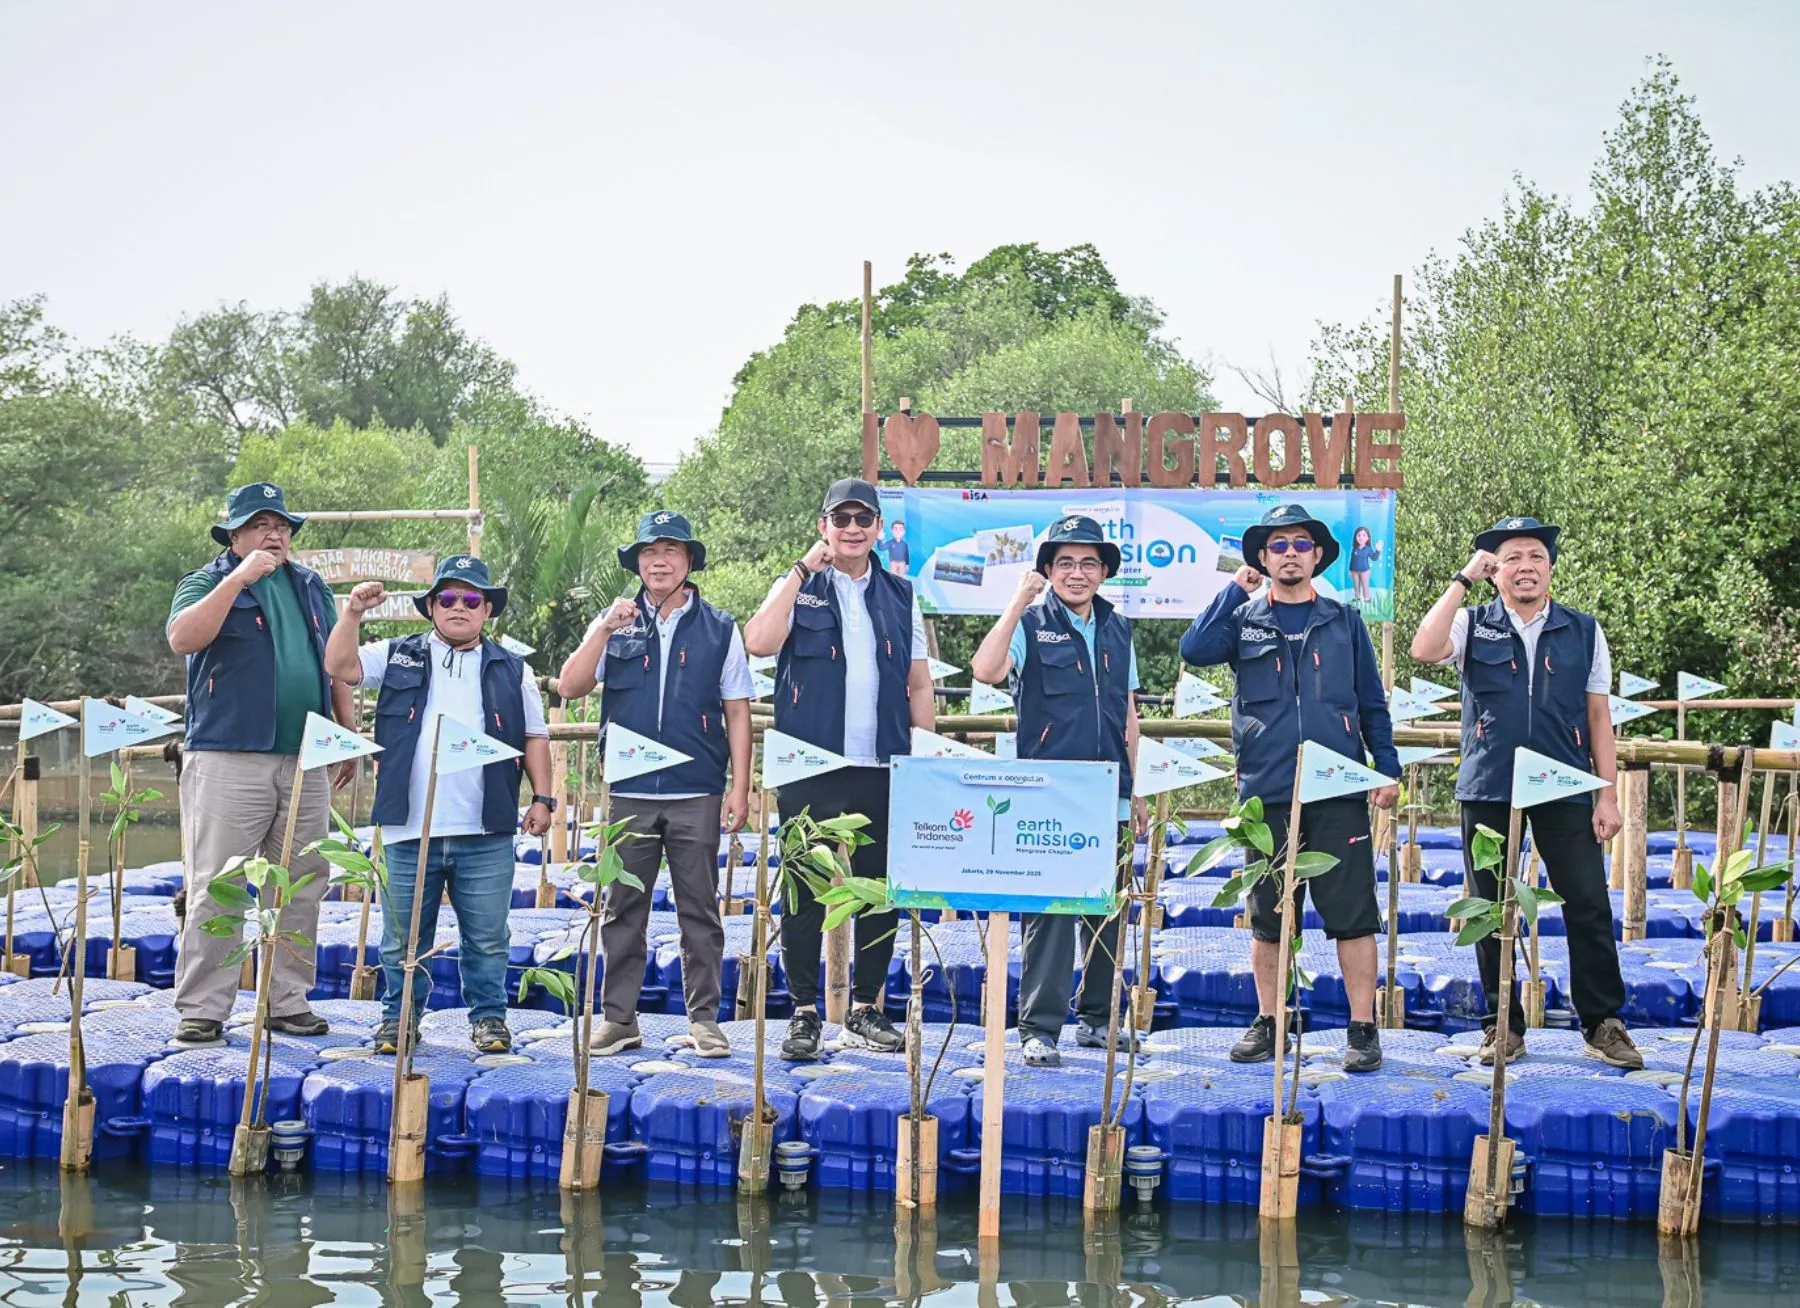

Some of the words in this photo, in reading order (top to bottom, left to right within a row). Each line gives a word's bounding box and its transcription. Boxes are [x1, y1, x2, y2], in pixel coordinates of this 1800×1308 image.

[981, 411, 1405, 488] MANGROVE
[1102, 518, 1135, 540] rth
[302, 550, 345, 569] LAJAR
[354, 549, 409, 568] JAKARTA
[1120, 540, 1197, 568] sion
[350, 562, 415, 582] MANGROVE
[963, 773, 997, 781] Centrum
[913, 821, 948, 832] Telkom
[1017, 818, 1063, 832] earth
[916, 832, 964, 842] Indonesia
[1016, 832, 1100, 850] mission
[1047, 848, 1074, 856] Chapter
